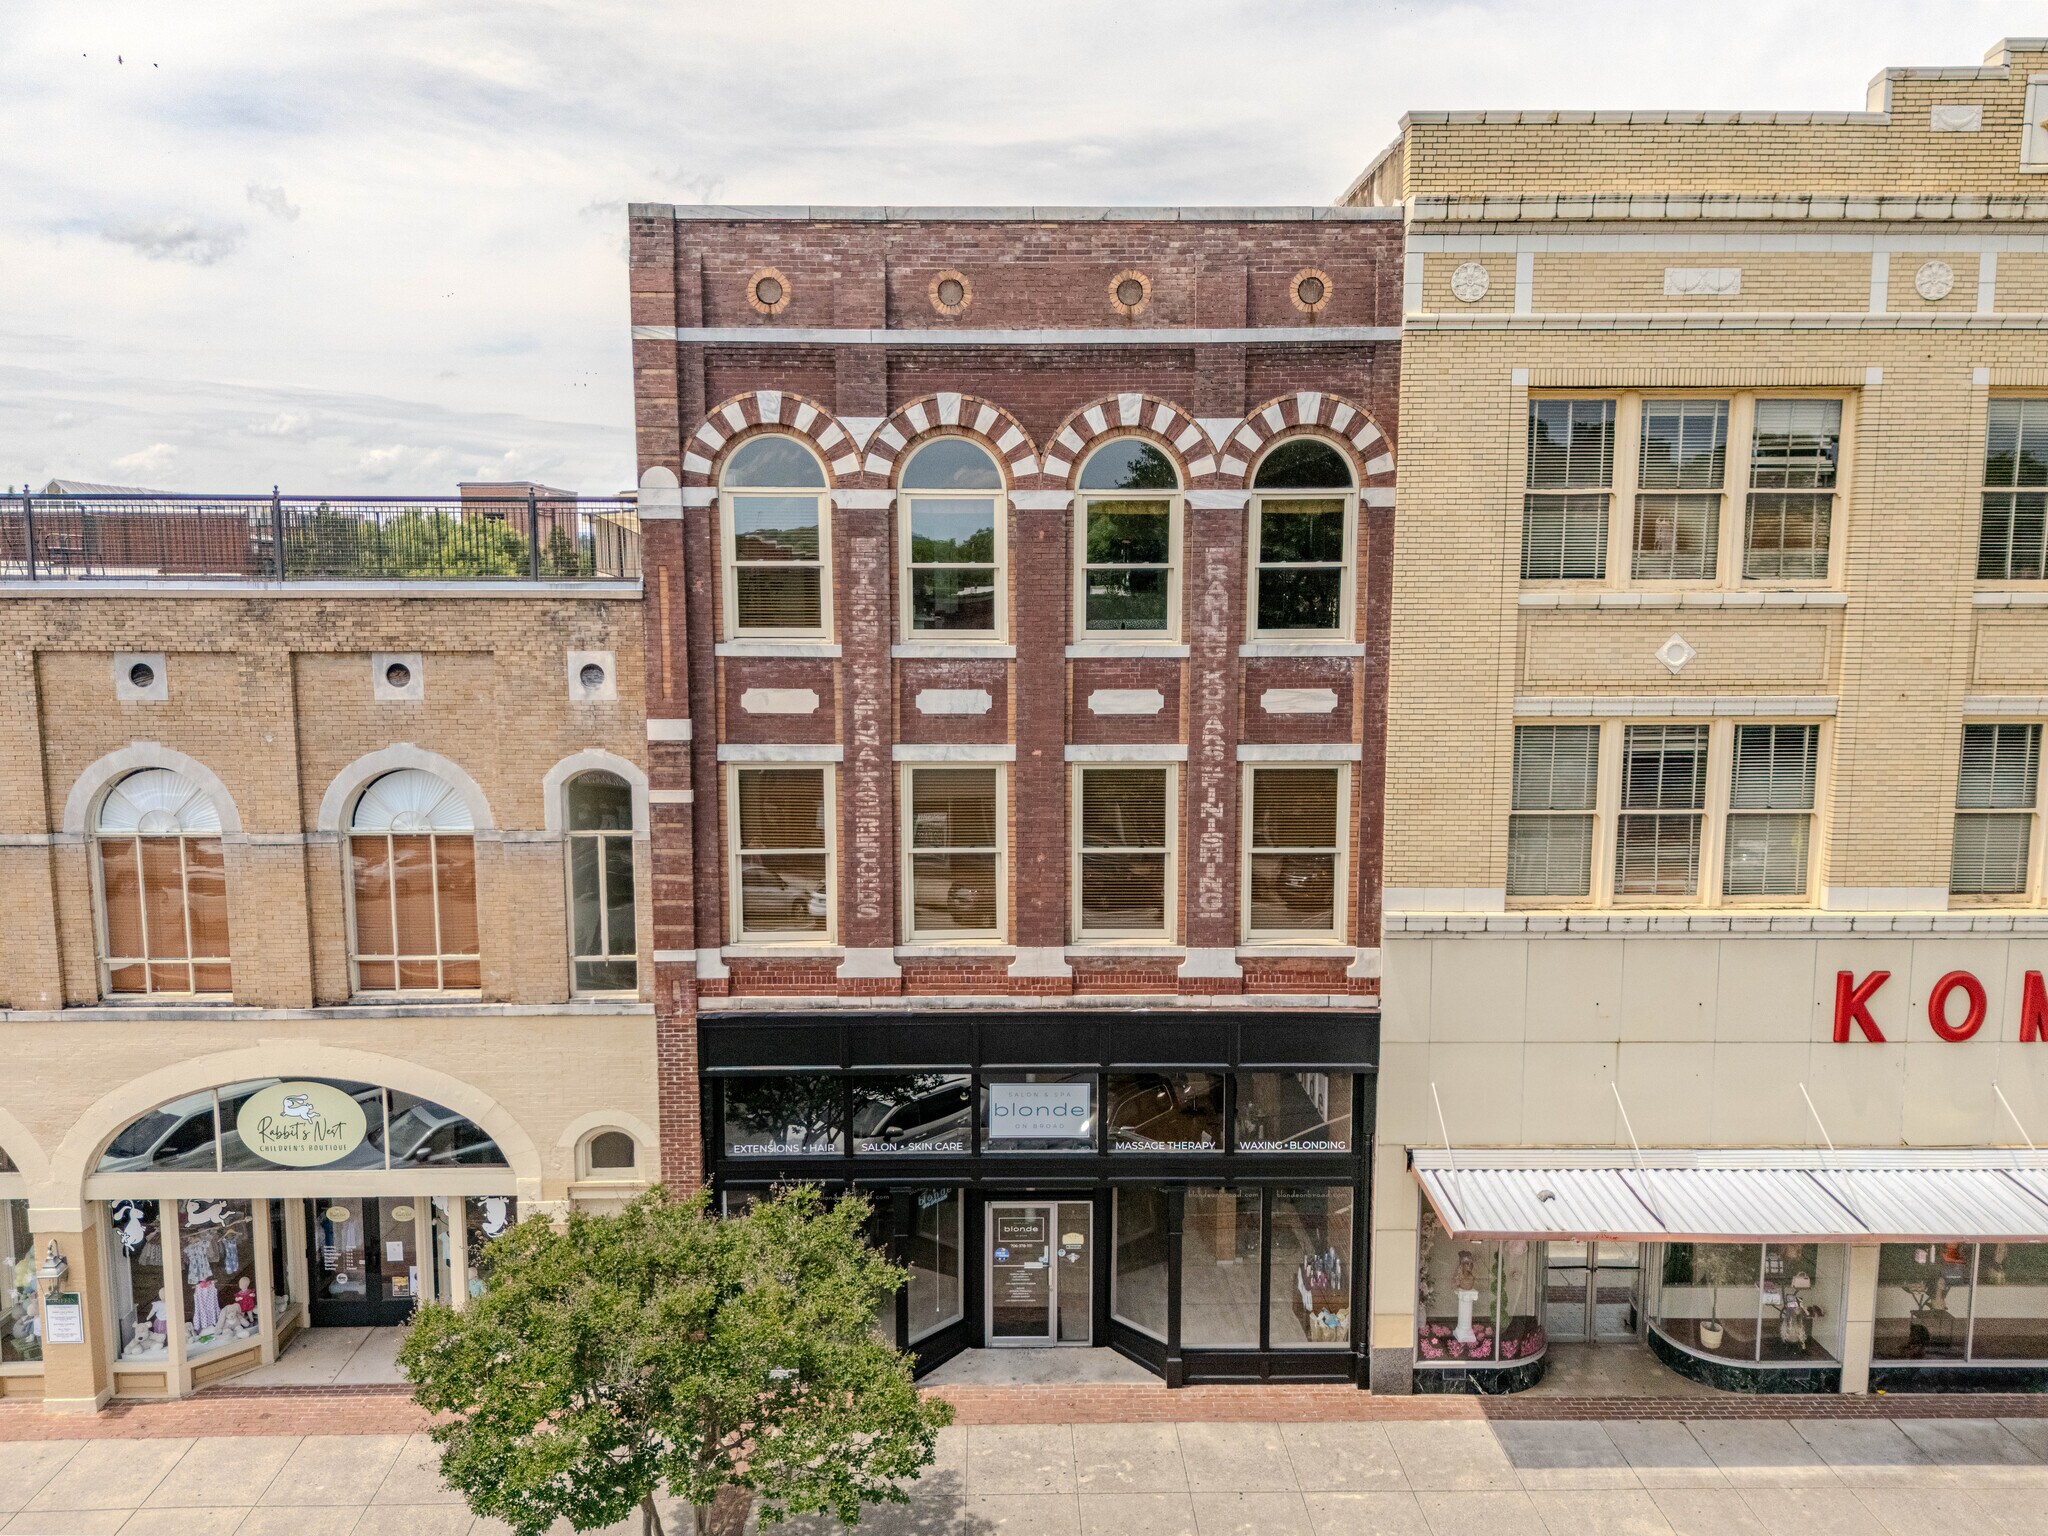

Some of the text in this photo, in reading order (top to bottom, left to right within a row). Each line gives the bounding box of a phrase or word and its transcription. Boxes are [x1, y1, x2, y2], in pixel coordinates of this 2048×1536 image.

[994, 1102, 1085, 1117] blonde
[257, 1115, 347, 1143] Rabbit's Nest
[259, 1144, 305, 1152] CHILDREN'S
[733, 1143, 835, 1154] EXTENSIONS HAIR
[861, 1142, 963, 1152] SALON SKIN CARE
[1115, 1141, 1216, 1150] MASSAGE THERAPY
[1240, 1141, 1346, 1150] WAXING BLONDING
[1003, 1225, 1039, 1233] blonde
